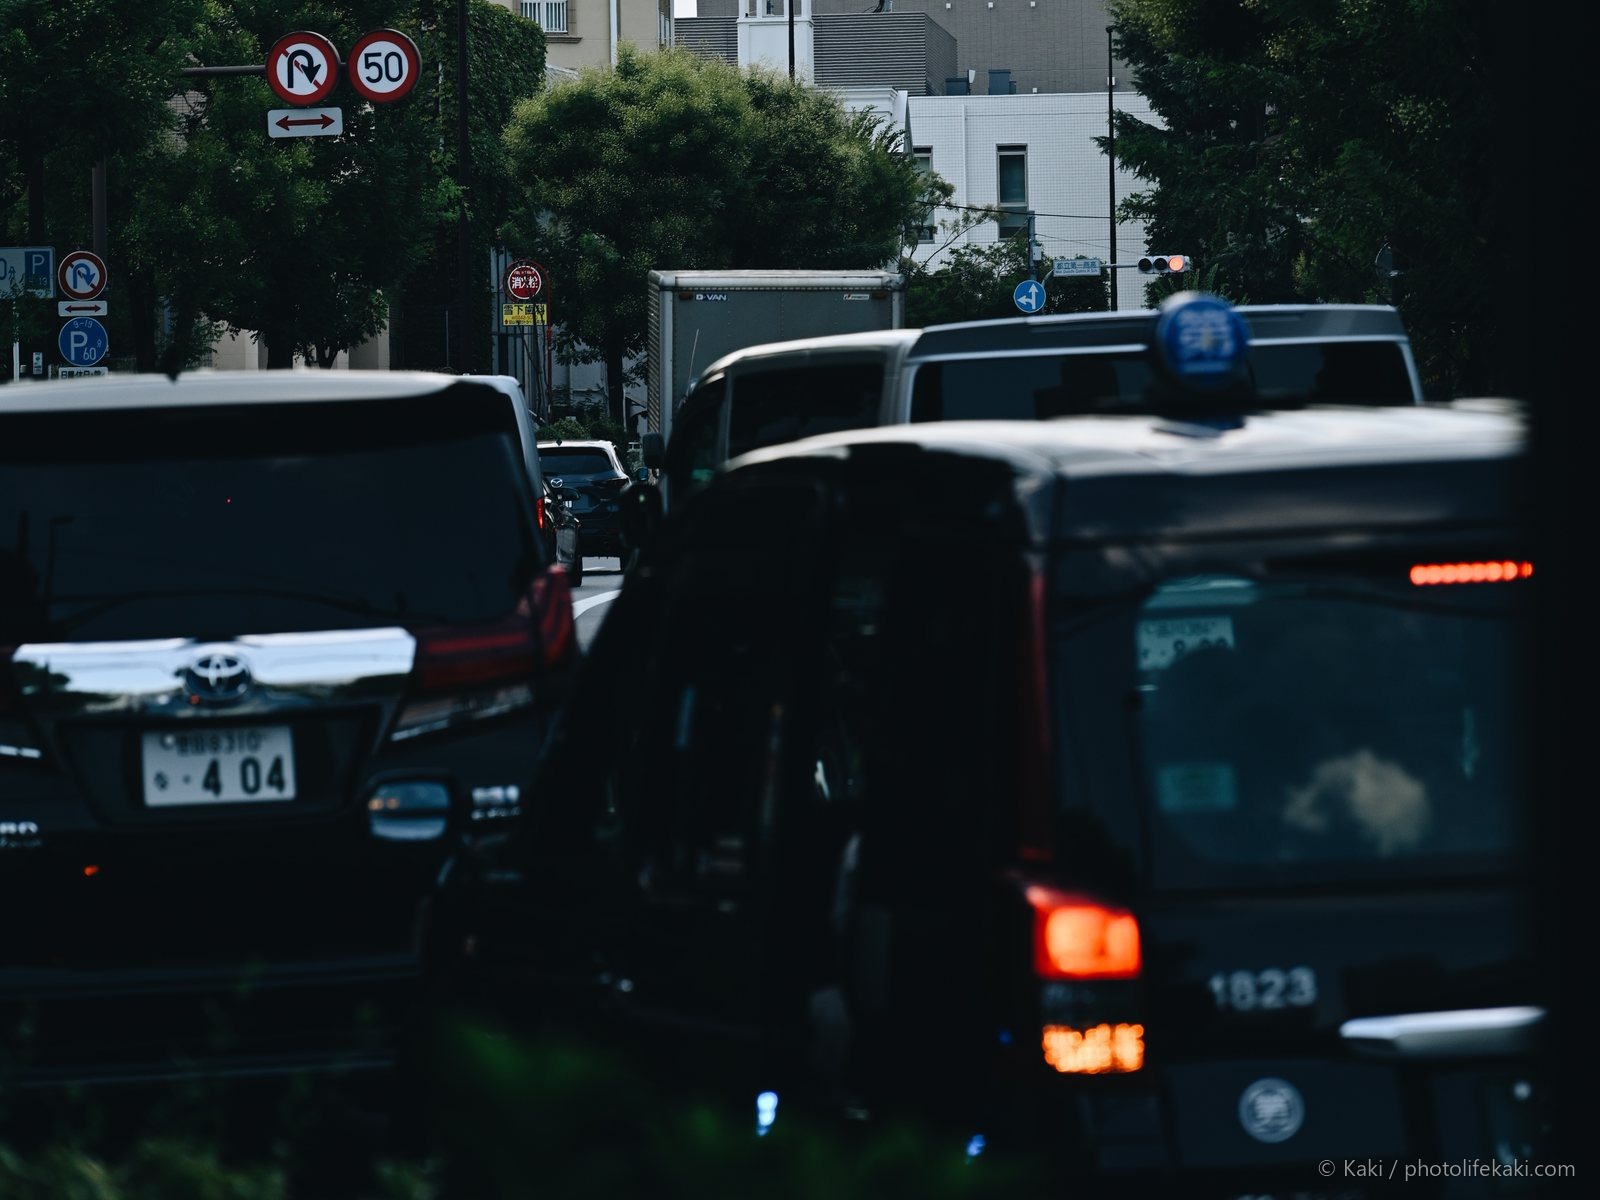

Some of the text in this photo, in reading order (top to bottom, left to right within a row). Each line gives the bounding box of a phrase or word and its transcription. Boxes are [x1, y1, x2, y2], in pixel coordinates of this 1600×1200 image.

[364, 51, 403, 83] 50
[511, 275, 538, 289] 消火栓
[70, 330, 88, 361] P
[1208, 965, 1318, 1011] 1823
